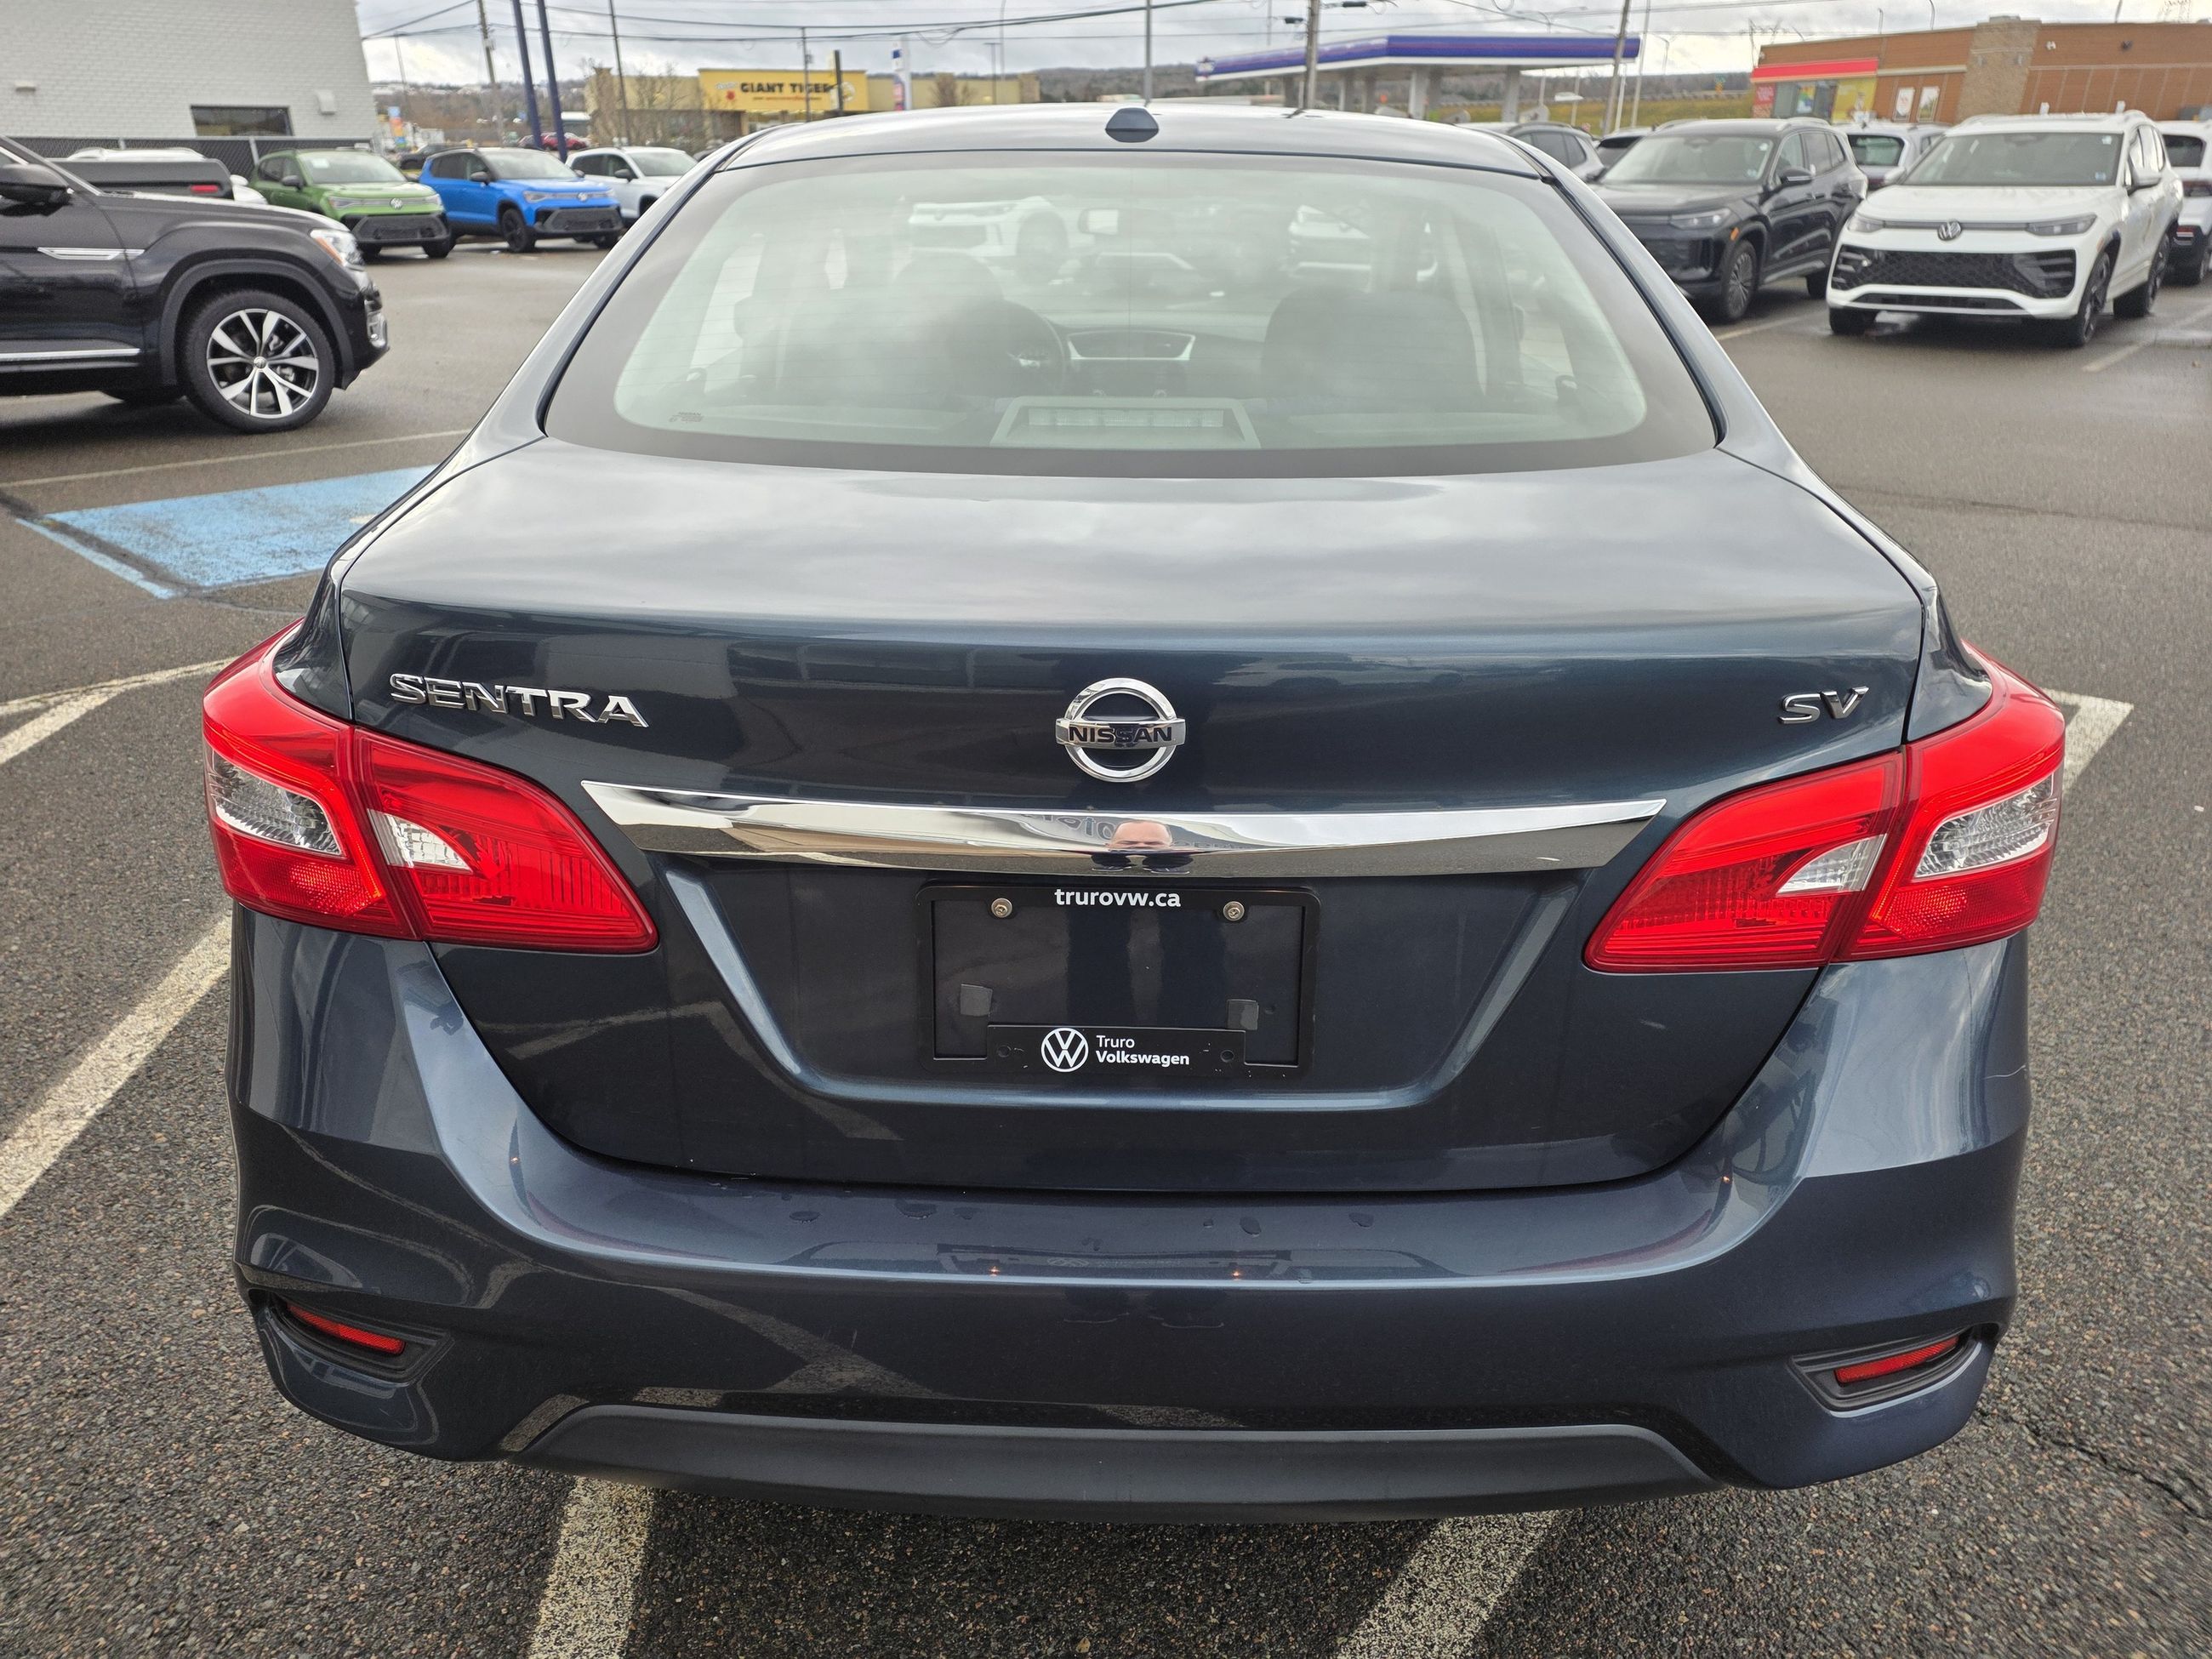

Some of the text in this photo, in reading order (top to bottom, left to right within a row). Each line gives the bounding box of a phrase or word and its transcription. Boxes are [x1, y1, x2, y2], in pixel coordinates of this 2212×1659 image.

[740, 83, 784, 93] GIANT
[390, 673, 649, 727] SENTRA
[1778, 686, 1869, 725] SV
[1069, 726, 1172, 743] NISSAN
[1054, 888, 1181, 907] trurovw.ca
[1096, 1035, 1135, 1048] Truro
[1096, 1050, 1189, 1067] Volkswagen
